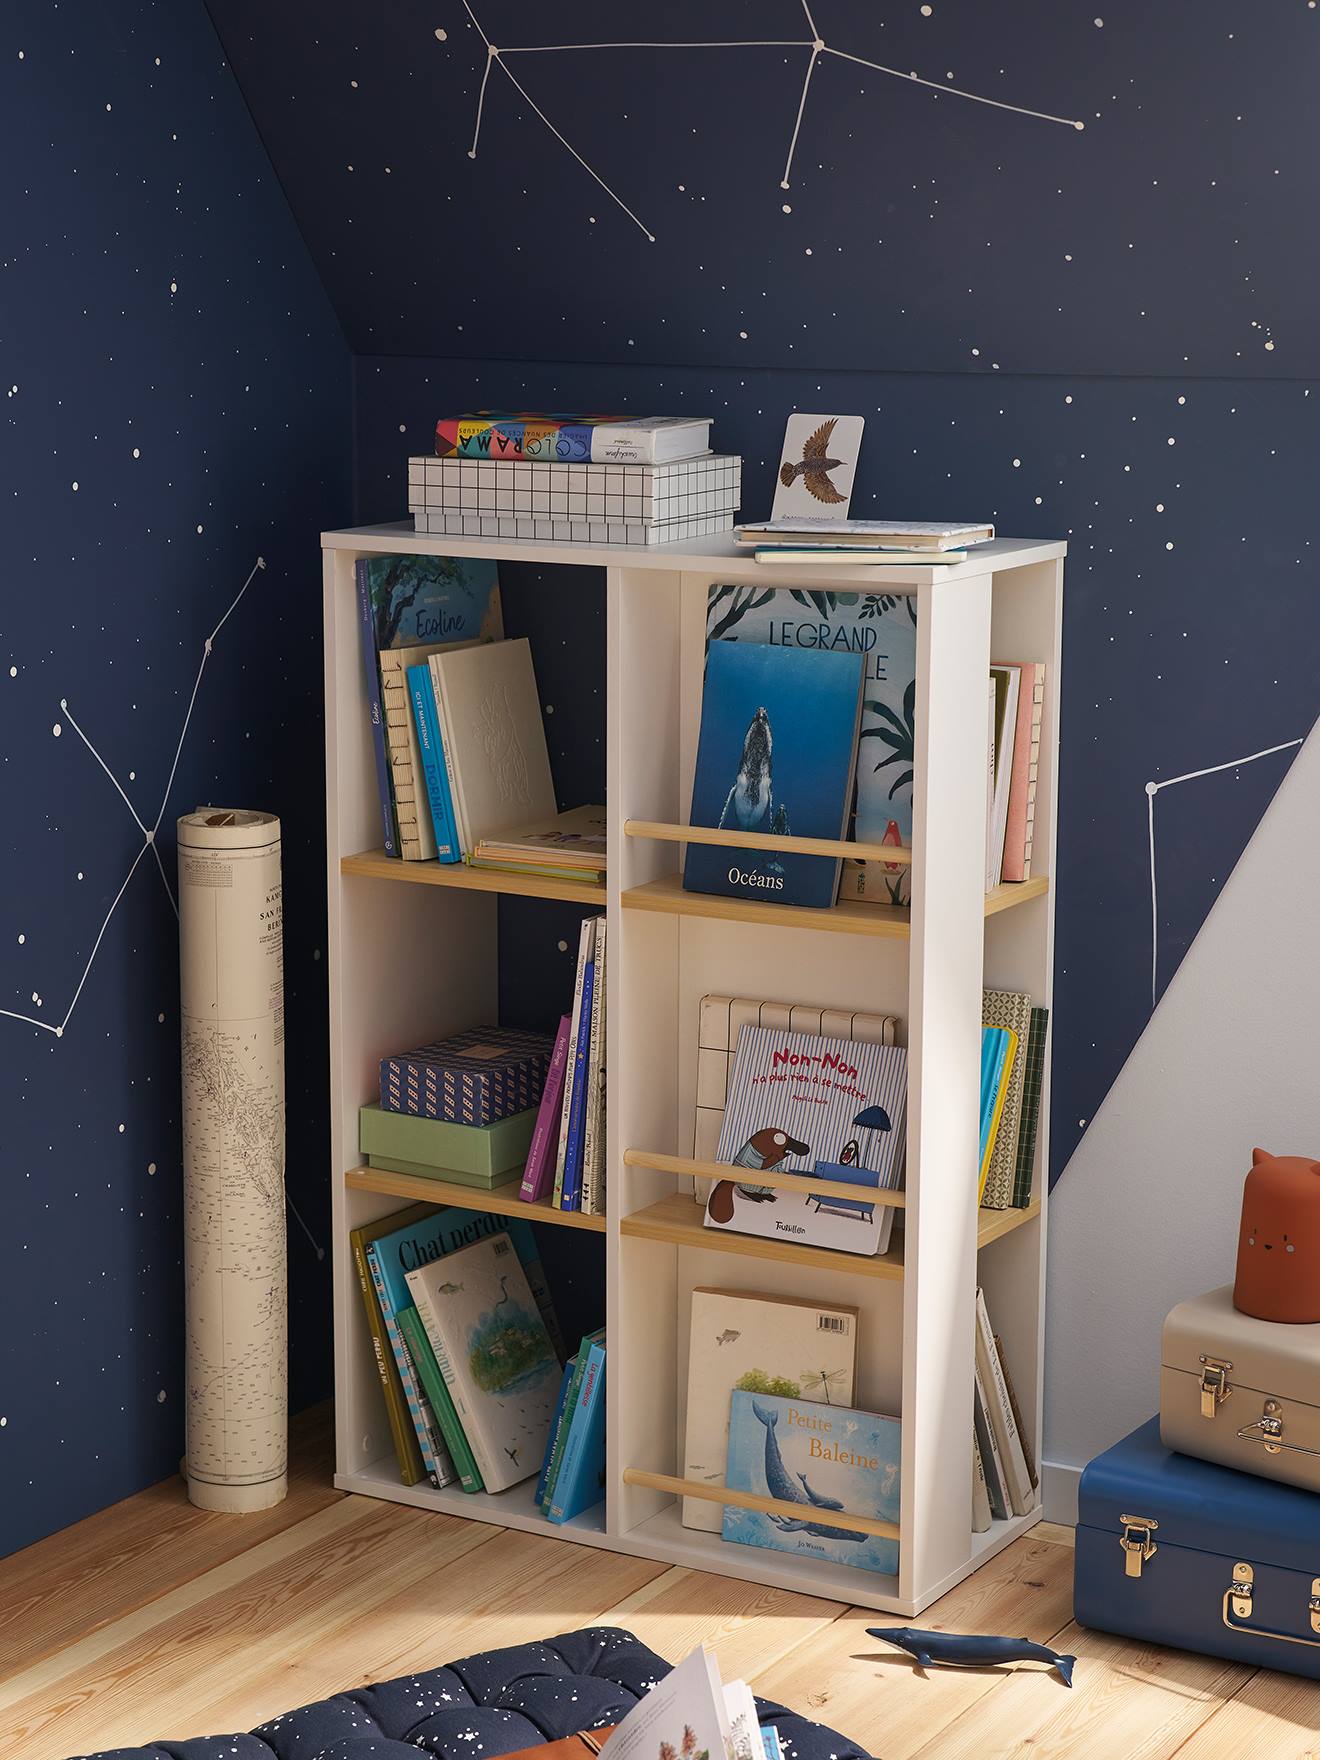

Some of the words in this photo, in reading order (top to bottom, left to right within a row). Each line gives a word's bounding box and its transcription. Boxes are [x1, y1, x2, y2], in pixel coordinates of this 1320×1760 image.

[459, 435, 587, 457] COLORAMA
[416, 609, 466, 639] Ecoline
[419, 710, 430, 750] MAINTENANT
[426, 763, 445, 821] DORMIR
[728, 867, 784, 890] Océans
[773, 1047, 858, 1080] Non-Non
[752, 1074, 767, 1085] n'a
[769, 1071, 788, 1085] plus
[791, 1072, 809, 1083] rien
[812, 1074, 818, 1084] à
[822, 1078, 832, 1088] se
[834, 1082, 867, 1102] mettre
[400, 1231, 448, 1271] Chat
[450, 1213, 510, 1250] perdu
[373, 1336, 384, 1359] PERDU
[377, 1360, 386, 1374] PEU
[788, 1407, 832, 1432] Petite
[808, 1437, 879, 1471] Baleine
